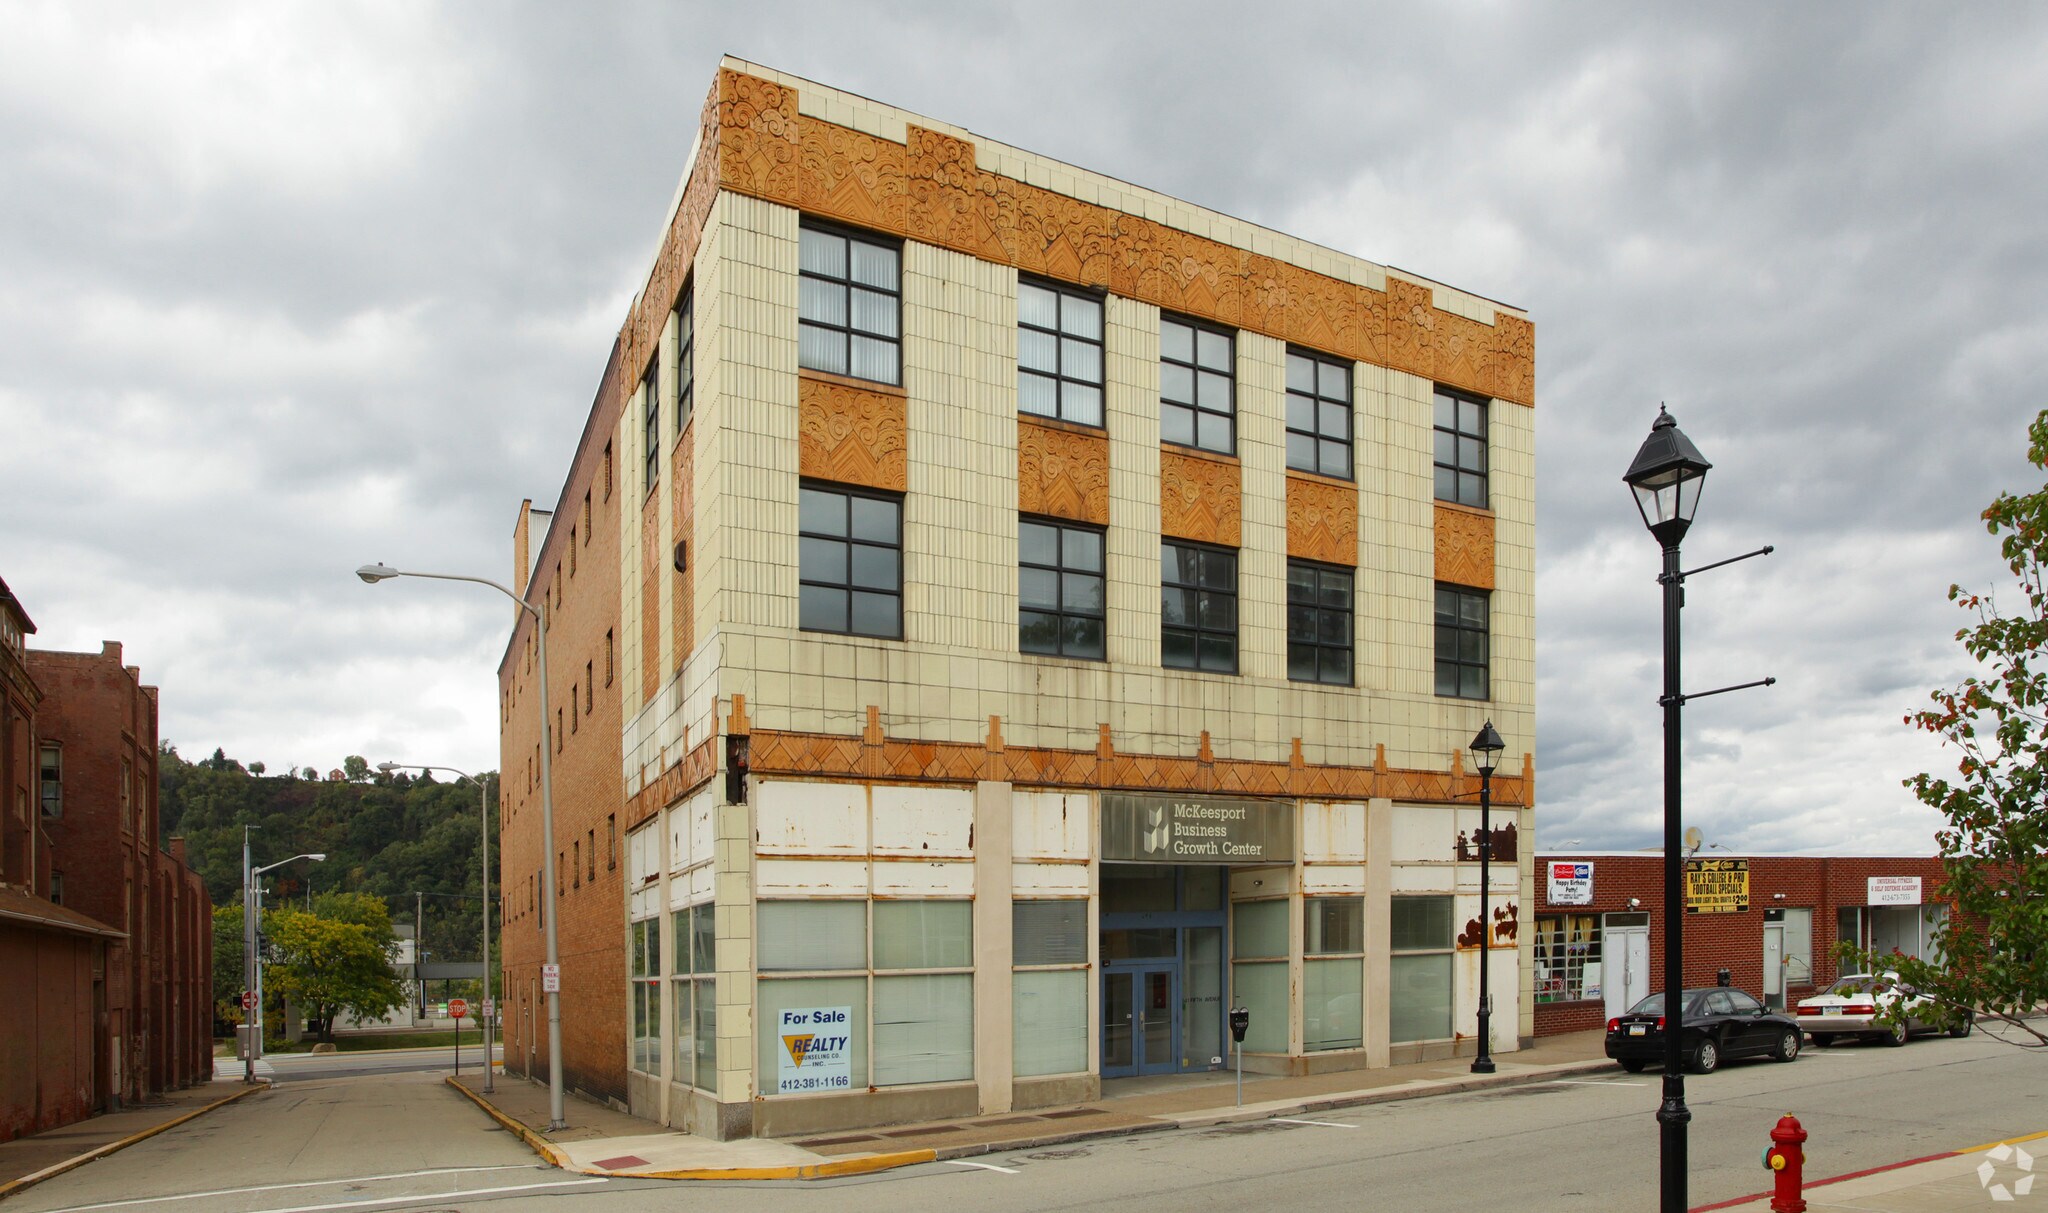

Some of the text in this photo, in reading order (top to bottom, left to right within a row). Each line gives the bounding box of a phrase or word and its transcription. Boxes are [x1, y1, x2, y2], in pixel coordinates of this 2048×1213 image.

[1174, 804, 1246, 821] McKeesport
[1174, 822, 1227, 837] Business
[1173, 841, 1263, 855] Growth Center
[1691, 872, 1745, 883] RAY'S COLLEGE & PRO
[1693, 883, 1742, 895] FOOTBALL SPECIALS
[450, 1005, 466, 1013] STOP
[784, 1010, 846, 1025] For Sale
[792, 1036, 848, 1053] REALTY
[797, 1053, 830, 1061] COUNSELING
[781, 1076, 848, 1090] 412-381-1166
